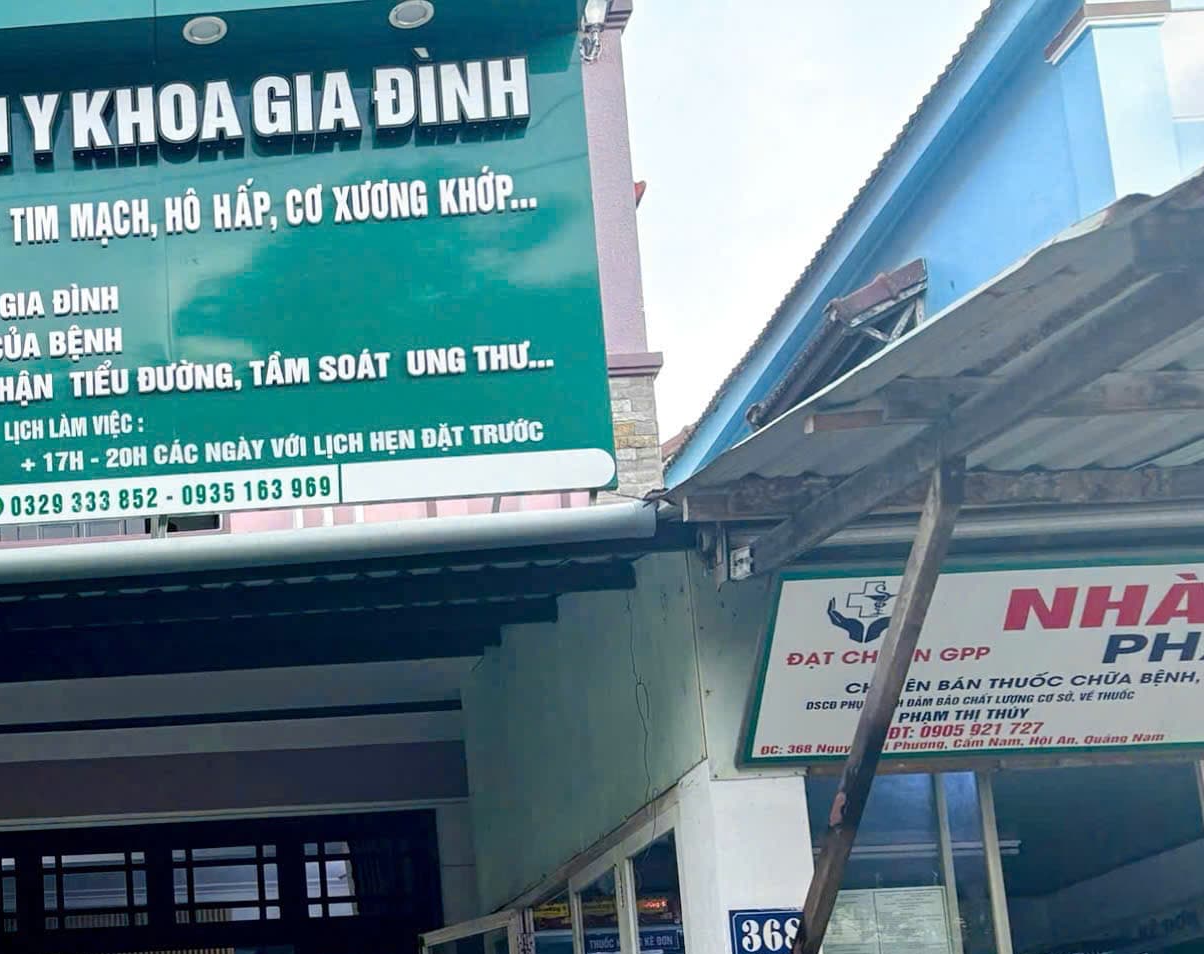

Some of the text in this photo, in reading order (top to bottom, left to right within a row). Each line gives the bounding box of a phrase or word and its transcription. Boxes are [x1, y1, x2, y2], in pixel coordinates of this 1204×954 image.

[23, 94, 62, 151] Y
[73, 80, 244, 149] KHOA
[252, 71, 361, 138] GIA
[373, 46, 529, 127] ĐÌNH
[10, 205, 58, 245] TIM
[70, 198, 158, 248] MẠCH,
[166, 187, 202, 235] HÔ
[214, 177, 277, 230] HẤP,
[286, 185, 324, 225] CƠ
[332, 178, 428, 222] XƯƠNG
[0, 290, 44, 319] GIA
[52, 284, 119, 316] ĐÌNH
[69, 360, 129, 399] TIỂU
[137, 357, 242, 394] ĐƯỜNG,
[250, 351, 309, 386] TẦM
[319, 349, 390, 382] SOÁT
[407, 347, 466, 377] UNG
[4, 410, 132, 445] LỊCH LÀM VIỆC
[43, 418, 544, 472] 17H 20H CÁC NGÀY VỚI LỊCH HẸN ĐẶT TRƯỚC
[10, 476, 331, 516] 0329 333 852 0935 163 969
[1003, 573, 1204, 631] NHÀ
[786, 647, 990, 669] ĐẠT CHN GPP
[846, 669, 1200, 694] CHÊN BÁN THUỐC CHỮA BỆNH,
[898, 709, 981, 724] PHẠM THỊ
[920, 724, 964, 738] 0905
[970, 722, 1002, 736] 921
[1010, 721, 1044, 735] 727
[788, 744, 812, 754] 368
[1132, 733, 1165, 742] Nam
[742, 918, 801, 952] 368
